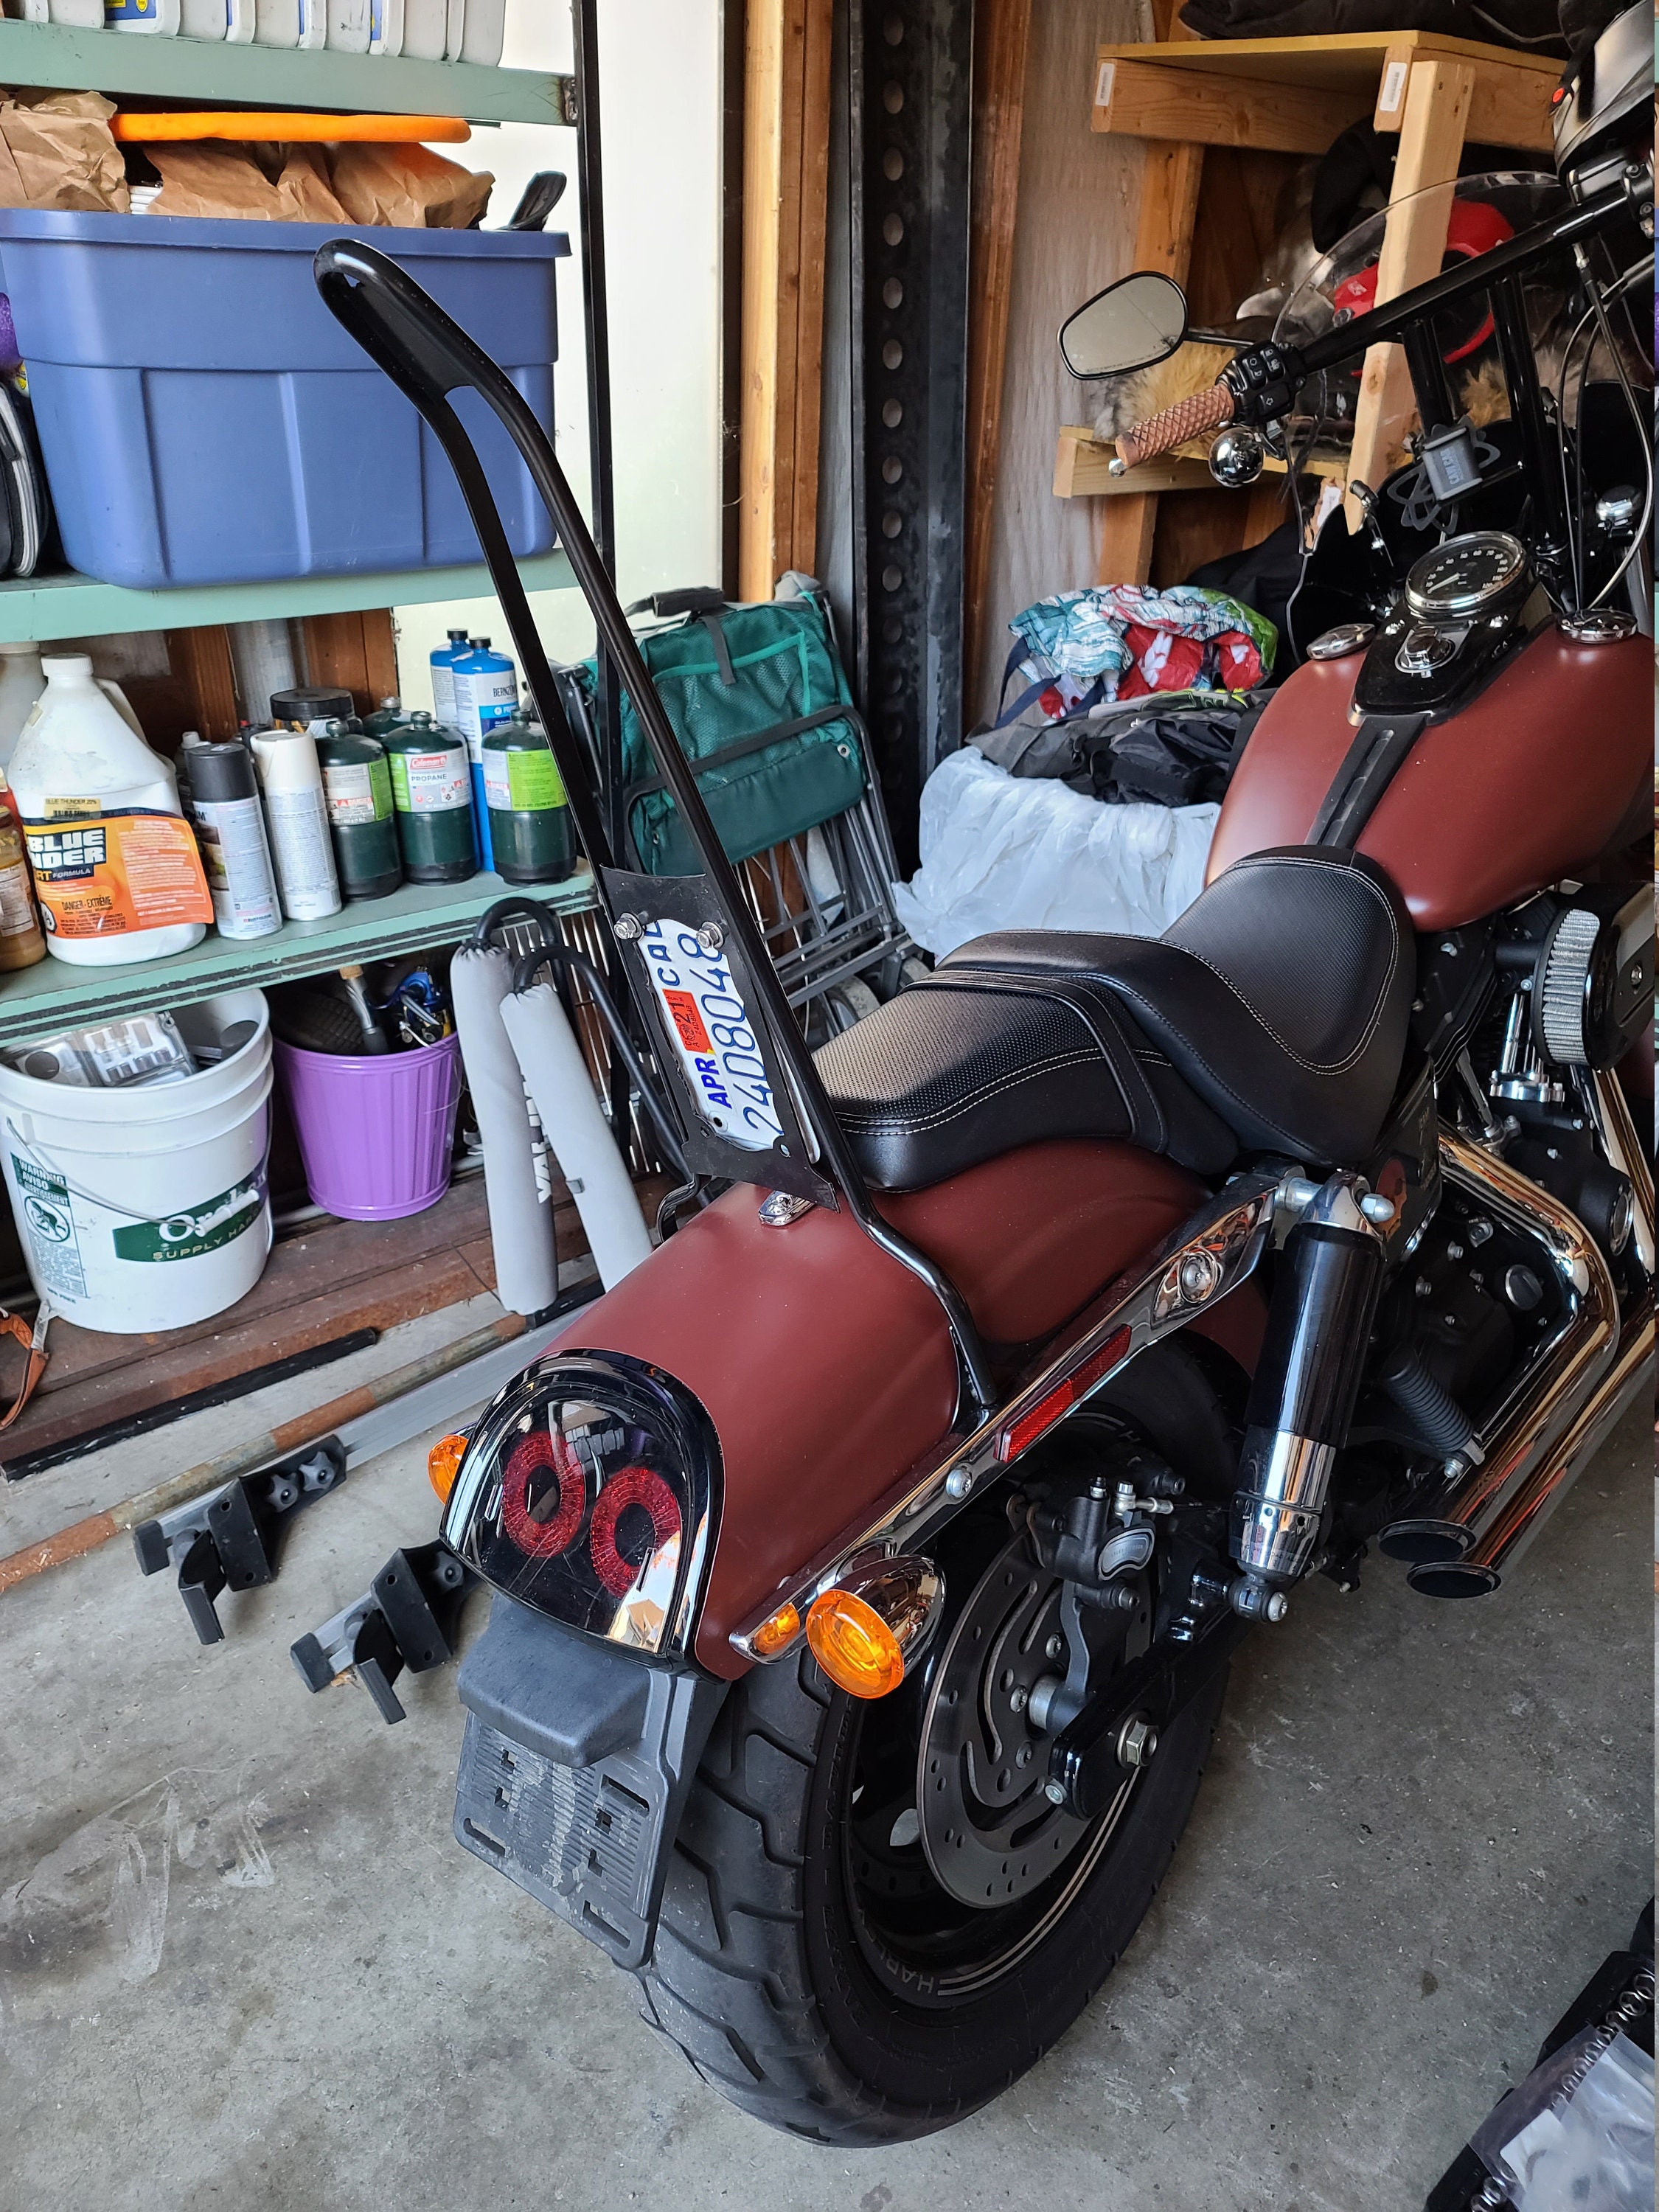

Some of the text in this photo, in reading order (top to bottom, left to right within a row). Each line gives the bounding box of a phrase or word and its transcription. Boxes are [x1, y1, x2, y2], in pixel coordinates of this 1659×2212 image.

[411, 773, 447, 782] PROPANE
[27, 829, 103, 852] BLUE
[52, 868, 91, 879] FORMULA
[669, 1002, 692, 1024] 21
[695, 1057, 733, 1109] APR
[22, 1171, 49, 1191] AVISO
[152, 1236, 223, 1261] SUPPLY
